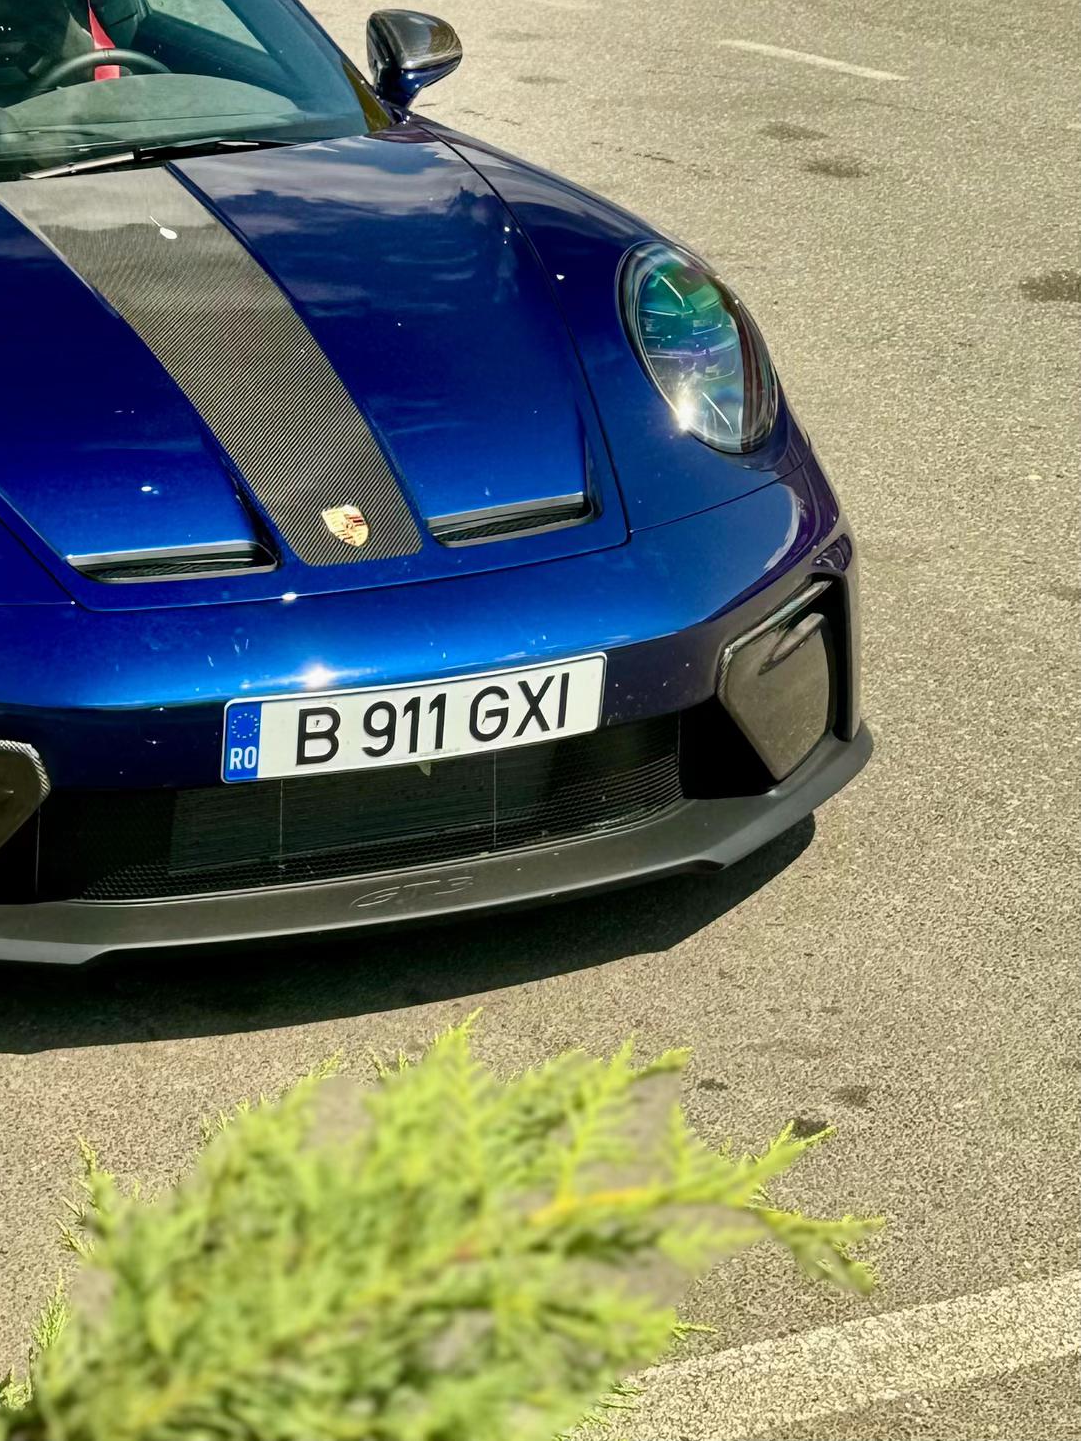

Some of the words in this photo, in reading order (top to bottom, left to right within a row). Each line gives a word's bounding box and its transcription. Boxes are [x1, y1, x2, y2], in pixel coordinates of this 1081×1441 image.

[296, 706, 341, 766] B
[362, 693, 446, 758] 911
[469, 672, 570, 742] GXI
[230, 746, 257, 770] RO
